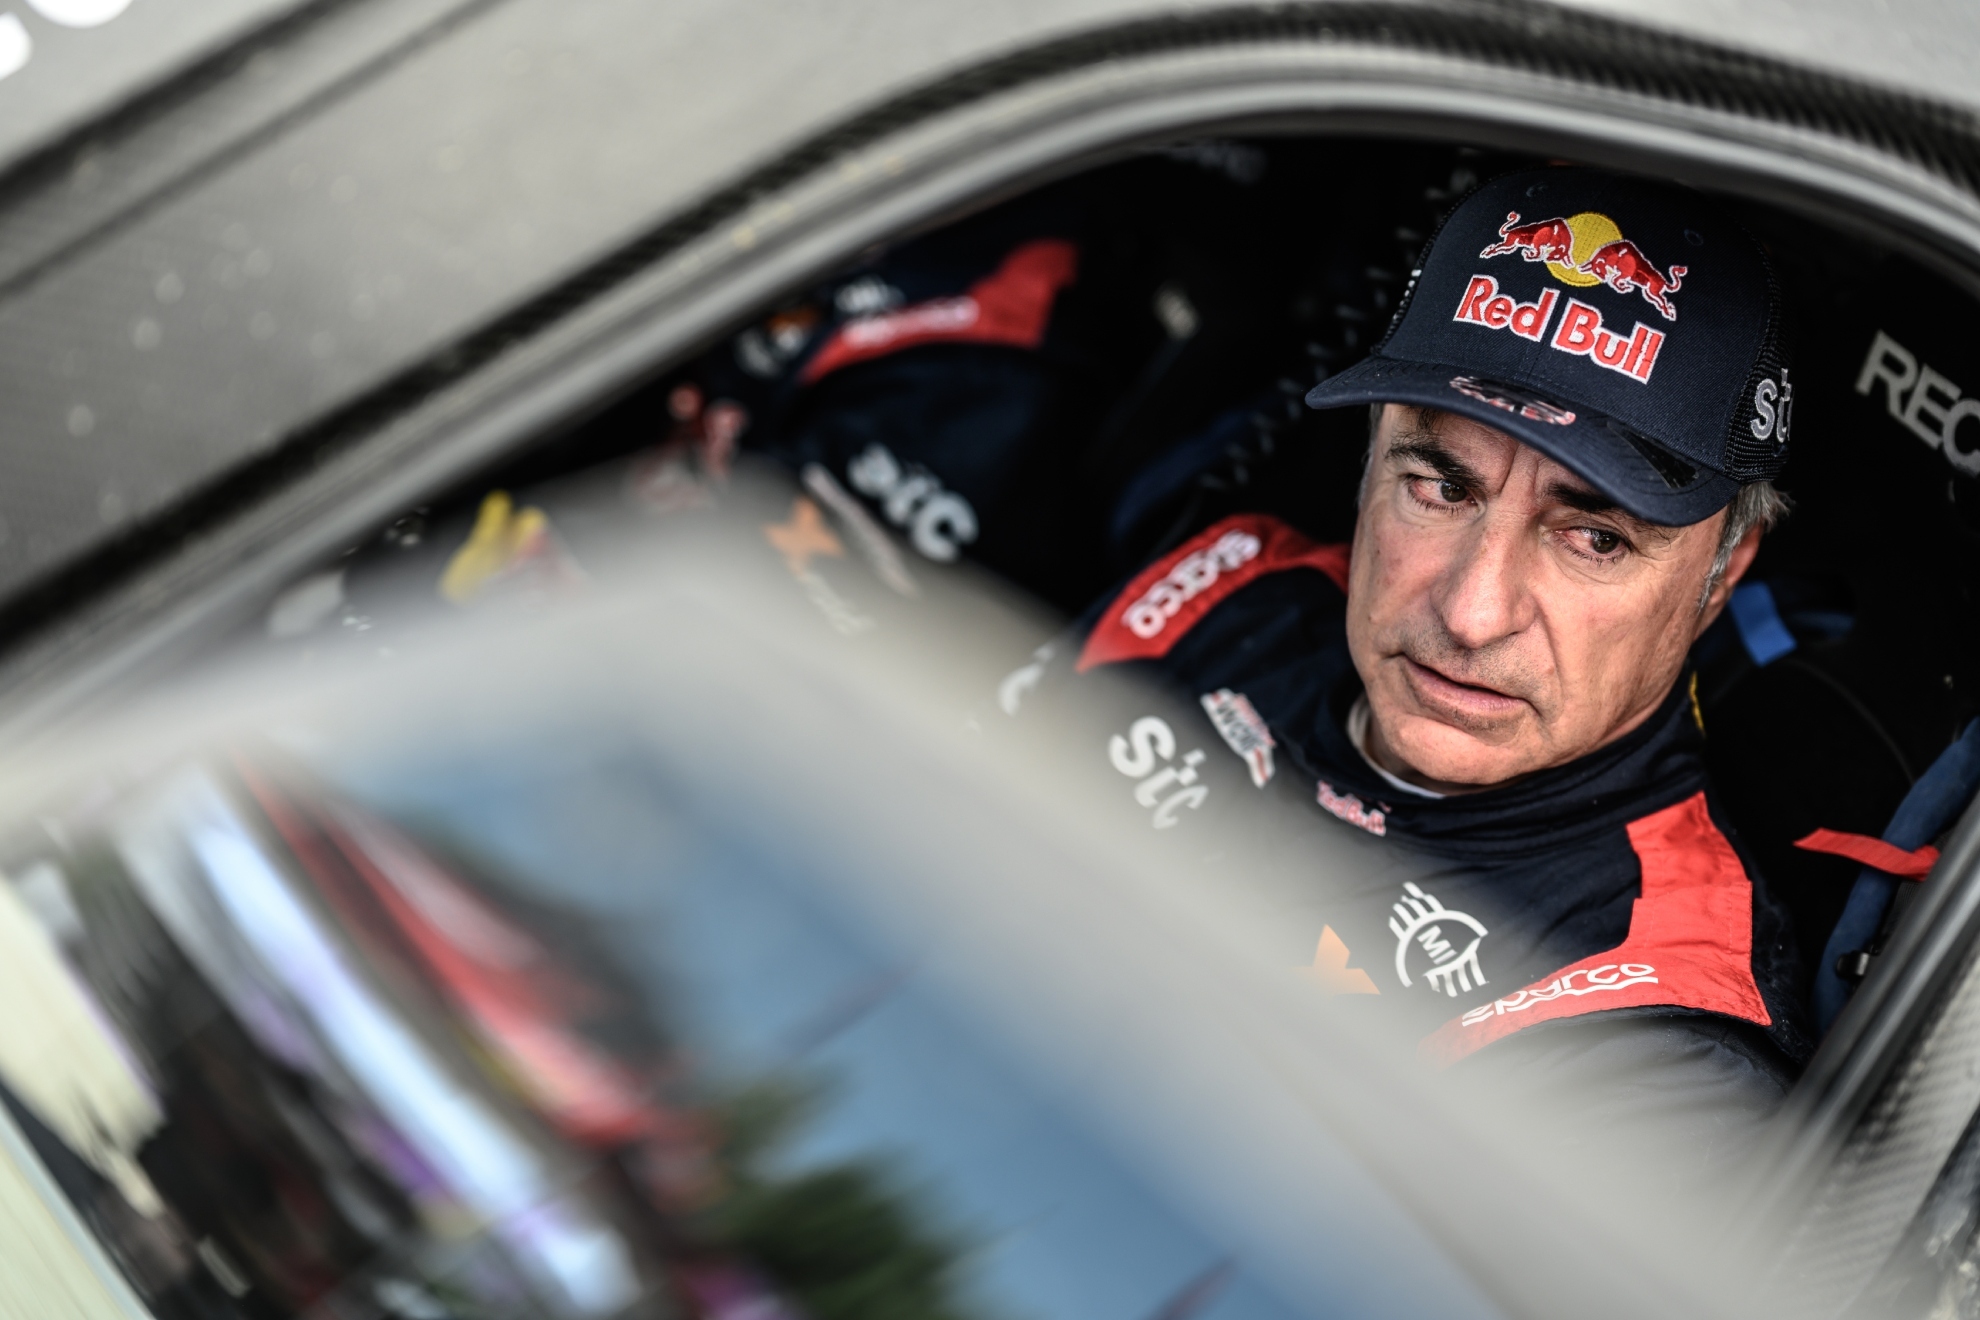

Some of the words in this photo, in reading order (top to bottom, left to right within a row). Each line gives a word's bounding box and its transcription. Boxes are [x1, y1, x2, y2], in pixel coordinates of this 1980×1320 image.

[1453, 274, 1560, 342] Red
[1551, 297, 1666, 384] Bull
[1750, 367, 1794, 443] st
[1108, 716, 1209, 829] stc
[1462, 963, 1657, 1027] sparco
